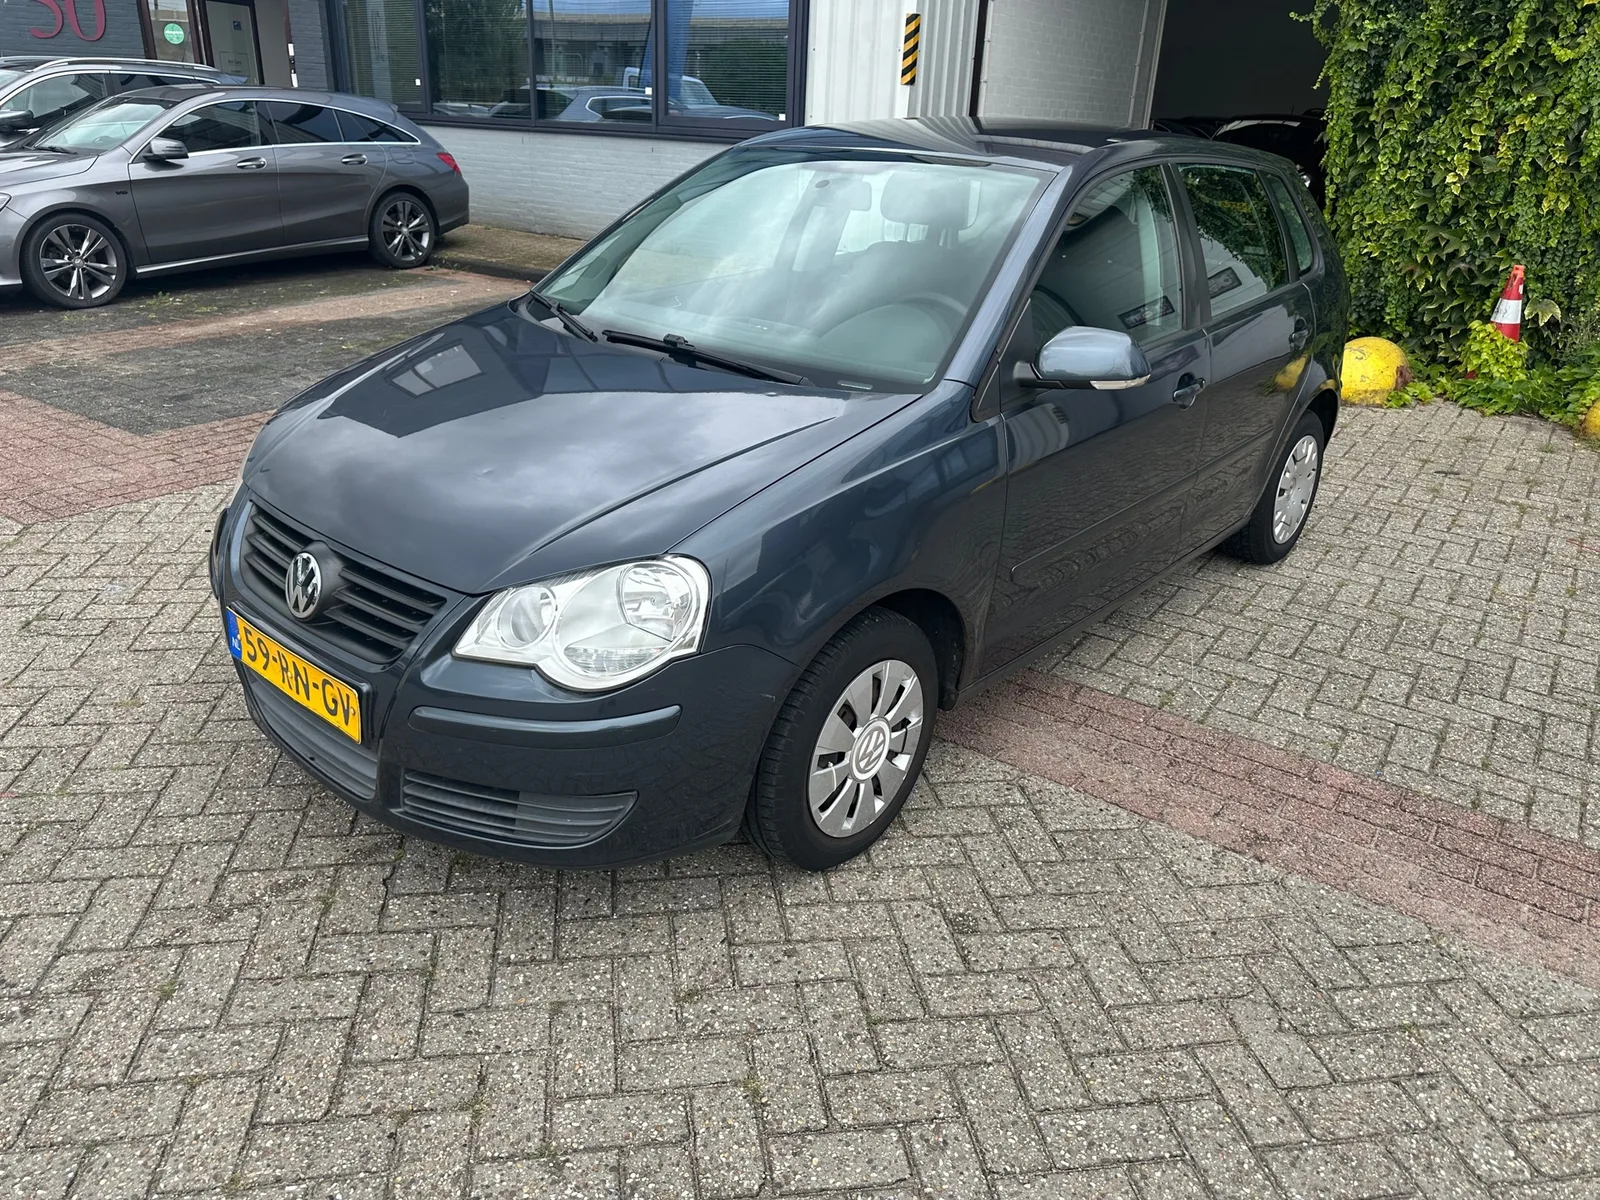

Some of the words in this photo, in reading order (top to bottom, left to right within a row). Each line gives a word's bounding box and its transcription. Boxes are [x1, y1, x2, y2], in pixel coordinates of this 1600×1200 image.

[286, 552, 322, 619] VW
[231, 636, 241, 651] NL
[243, 626, 350, 726] 59-RN-GV
[856, 726, 888, 774] VW
